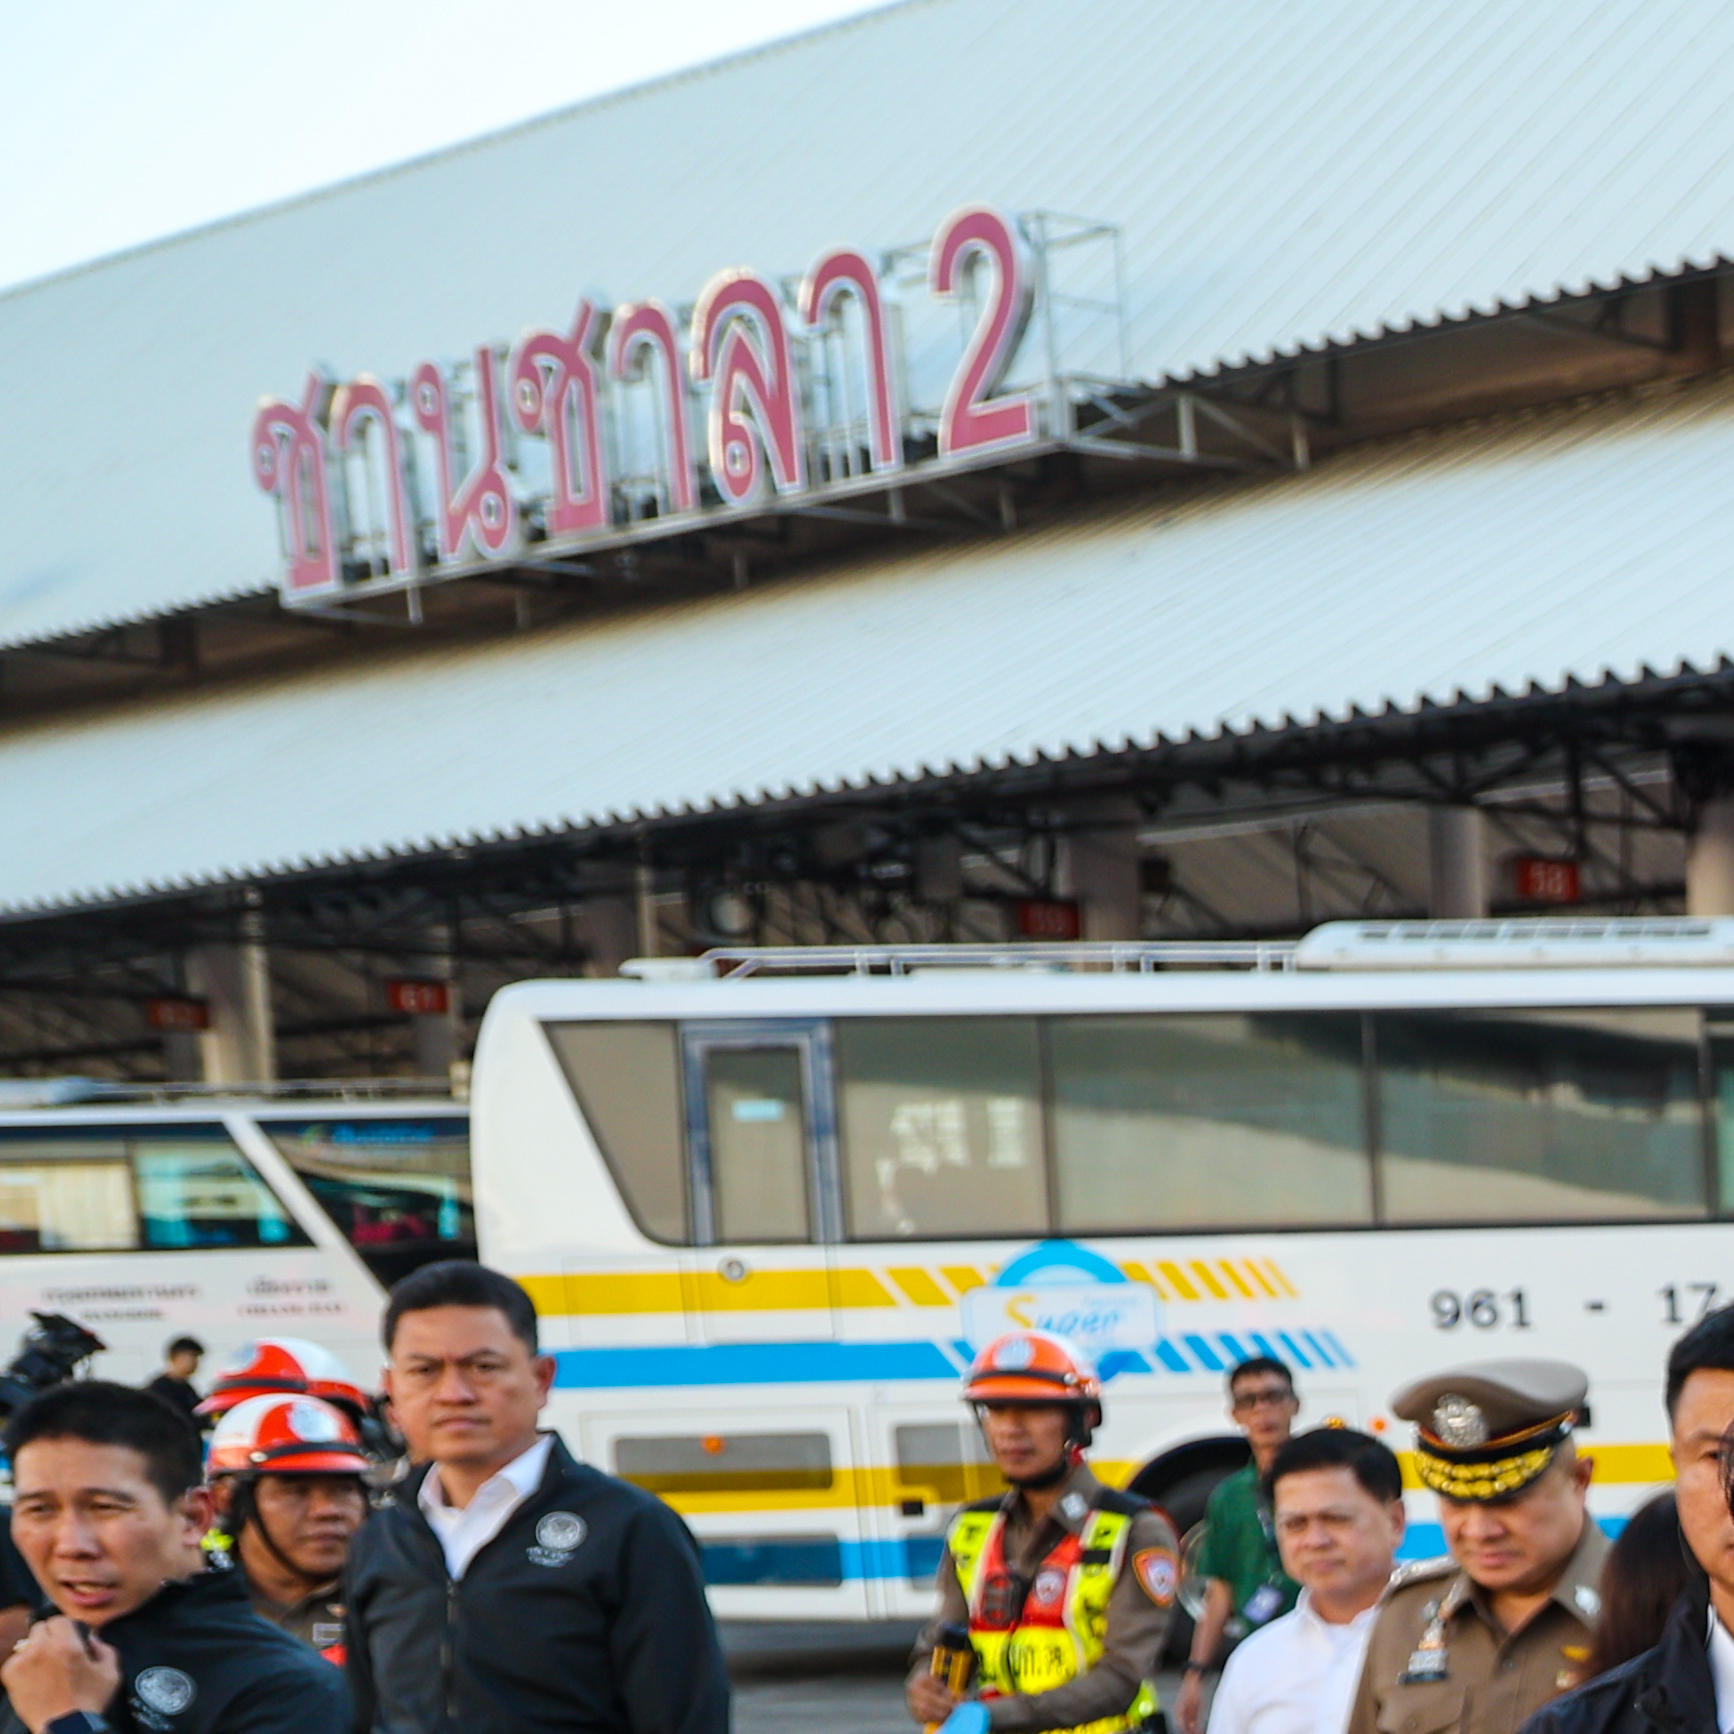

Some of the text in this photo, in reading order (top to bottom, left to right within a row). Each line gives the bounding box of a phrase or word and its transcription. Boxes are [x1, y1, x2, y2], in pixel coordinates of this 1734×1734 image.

[250, 200, 1042, 604] ชานชาลา 2
[1430, 1287, 1531, 1330] 961
